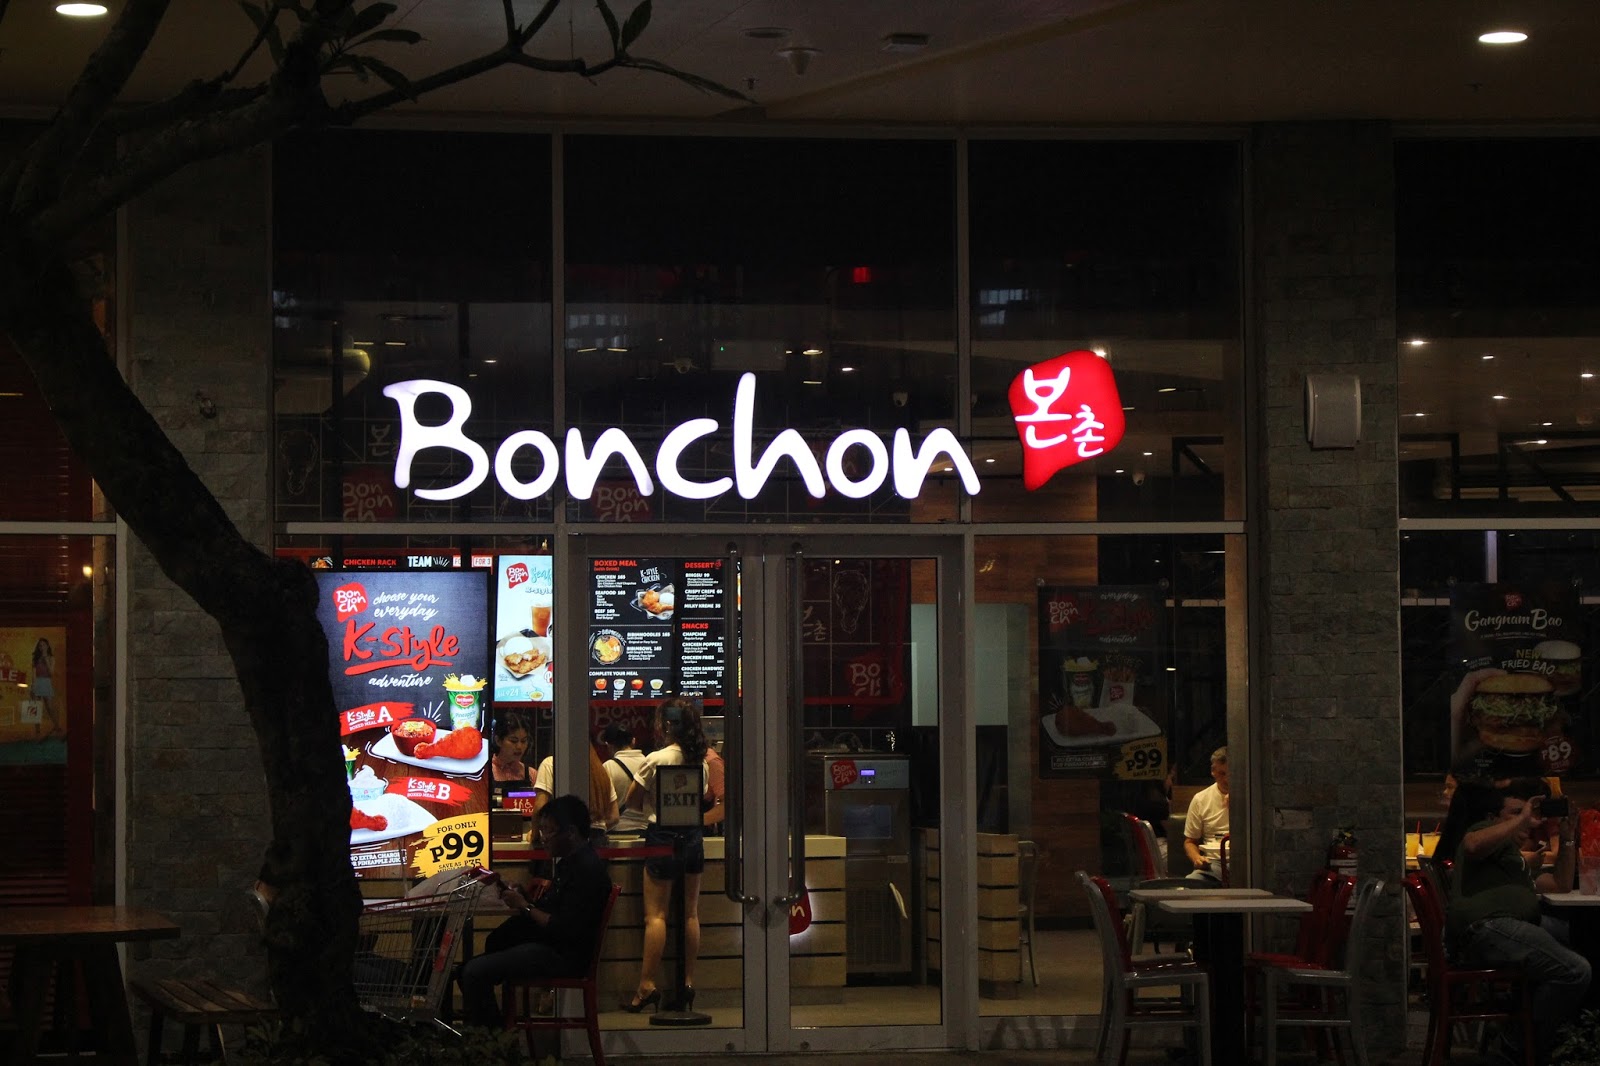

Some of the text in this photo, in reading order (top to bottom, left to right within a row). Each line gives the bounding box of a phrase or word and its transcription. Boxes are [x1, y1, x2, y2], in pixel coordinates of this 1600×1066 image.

[383, 372, 981, 500] Bonchon
[343, 558, 397, 566] CHICKEN RACK
[407, 555, 433, 568] TEAM
[641, 574, 660, 584] CHICKEN
[373, 591, 440, 606] choose your
[373, 602, 439, 621] everyday
[1464, 608, 1563, 632] Gangnam Bao
[343, 619, 460, 672] K-Style
[1501, 659, 1531, 670] FRIED
[1531, 660, 1556, 675] BAO
[368, 672, 434, 688] adventure
[346, 706, 394, 725] K-Style A
[407, 778, 451, 800] K-Style B
[663, 793, 698, 807] EXIT
[437, 821, 477, 834] FOR ONLY
